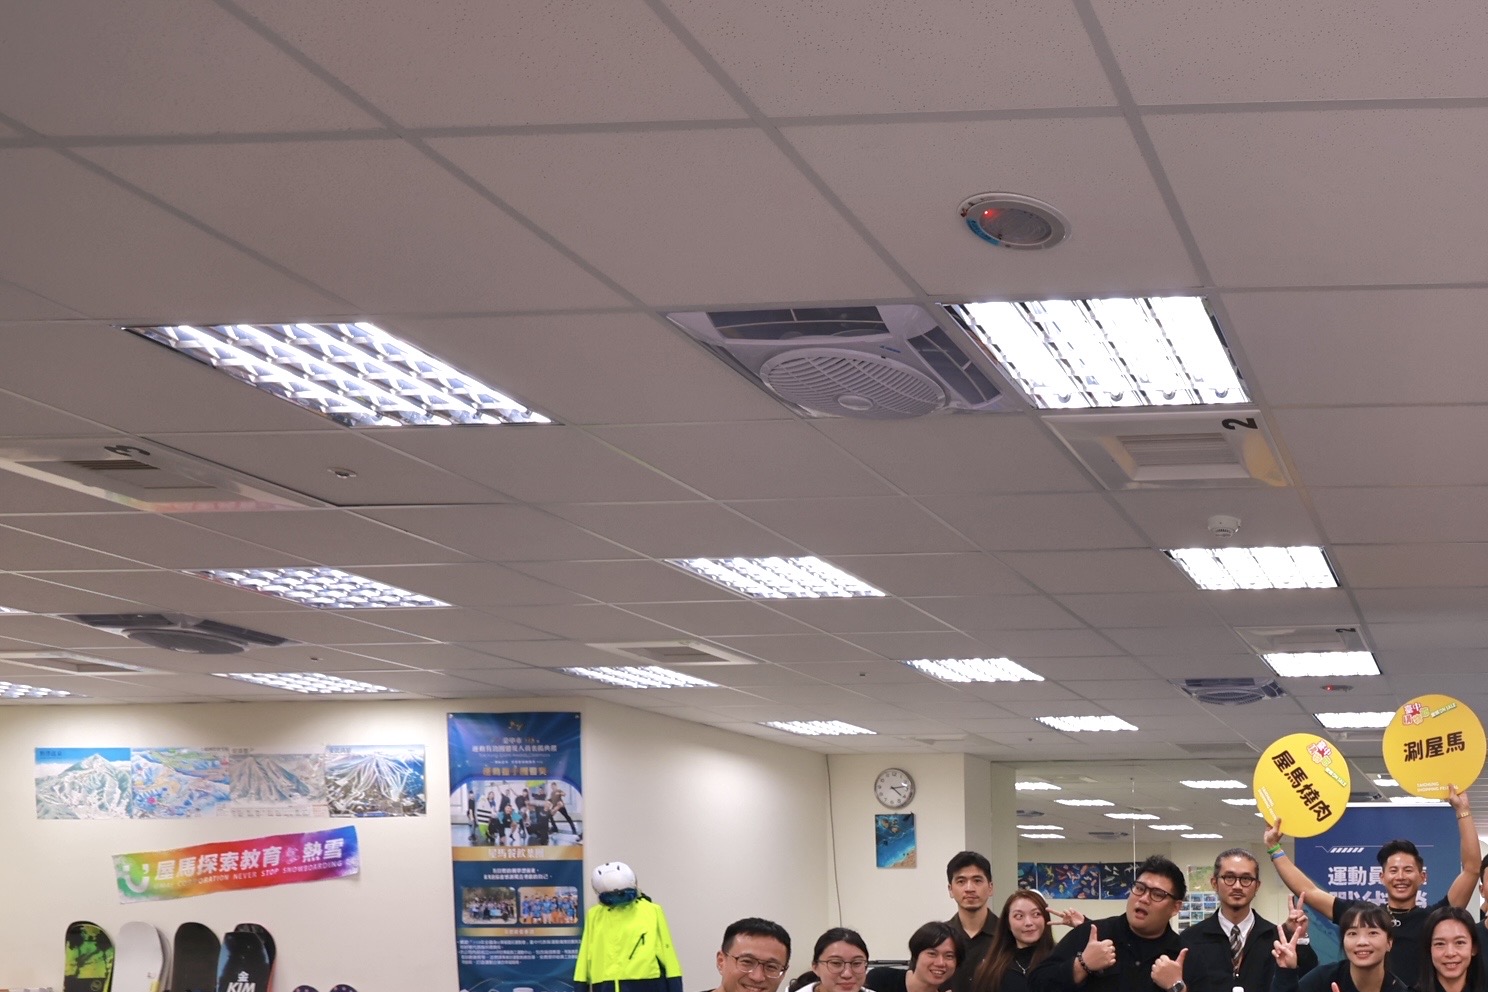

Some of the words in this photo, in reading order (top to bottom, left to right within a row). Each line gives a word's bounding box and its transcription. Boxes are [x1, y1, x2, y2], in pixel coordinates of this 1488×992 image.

[1403, 731, 1466, 763] 涮屋馬
[1271, 750, 1332, 822] 屋馬燒肉
[155, 846, 282, 881] 屋馬探索教育
[302, 838, 345, 863] 熱雪
[233, 871, 257, 880] NEVER
[261, 867, 279, 877] STOP
[282, 861, 344, 875] SNOWBOARDING
[237, 970, 249, 983] 金
